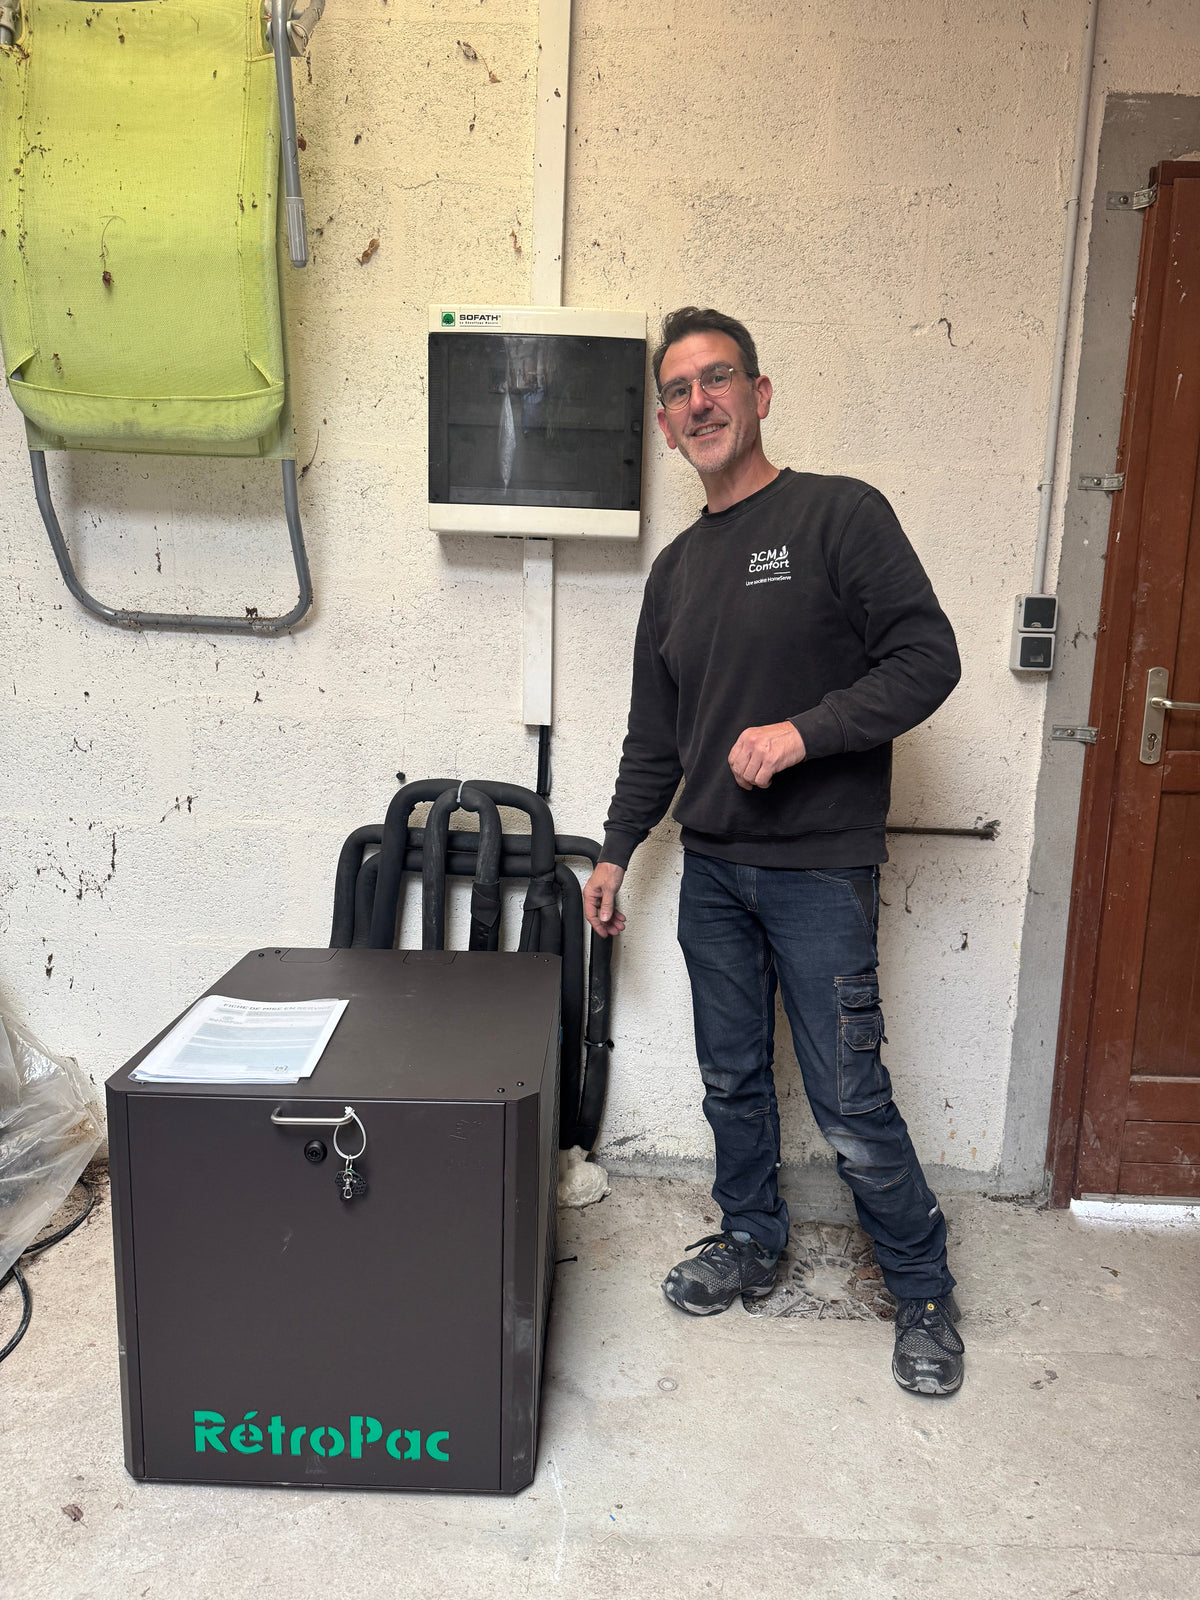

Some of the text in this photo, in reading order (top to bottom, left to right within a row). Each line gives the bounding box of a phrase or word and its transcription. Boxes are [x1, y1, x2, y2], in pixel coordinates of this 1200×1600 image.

[750, 549, 777, 564] JCM
[749, 560, 790, 573] Confort
[194, 1410, 450, 1462] RétroPac
